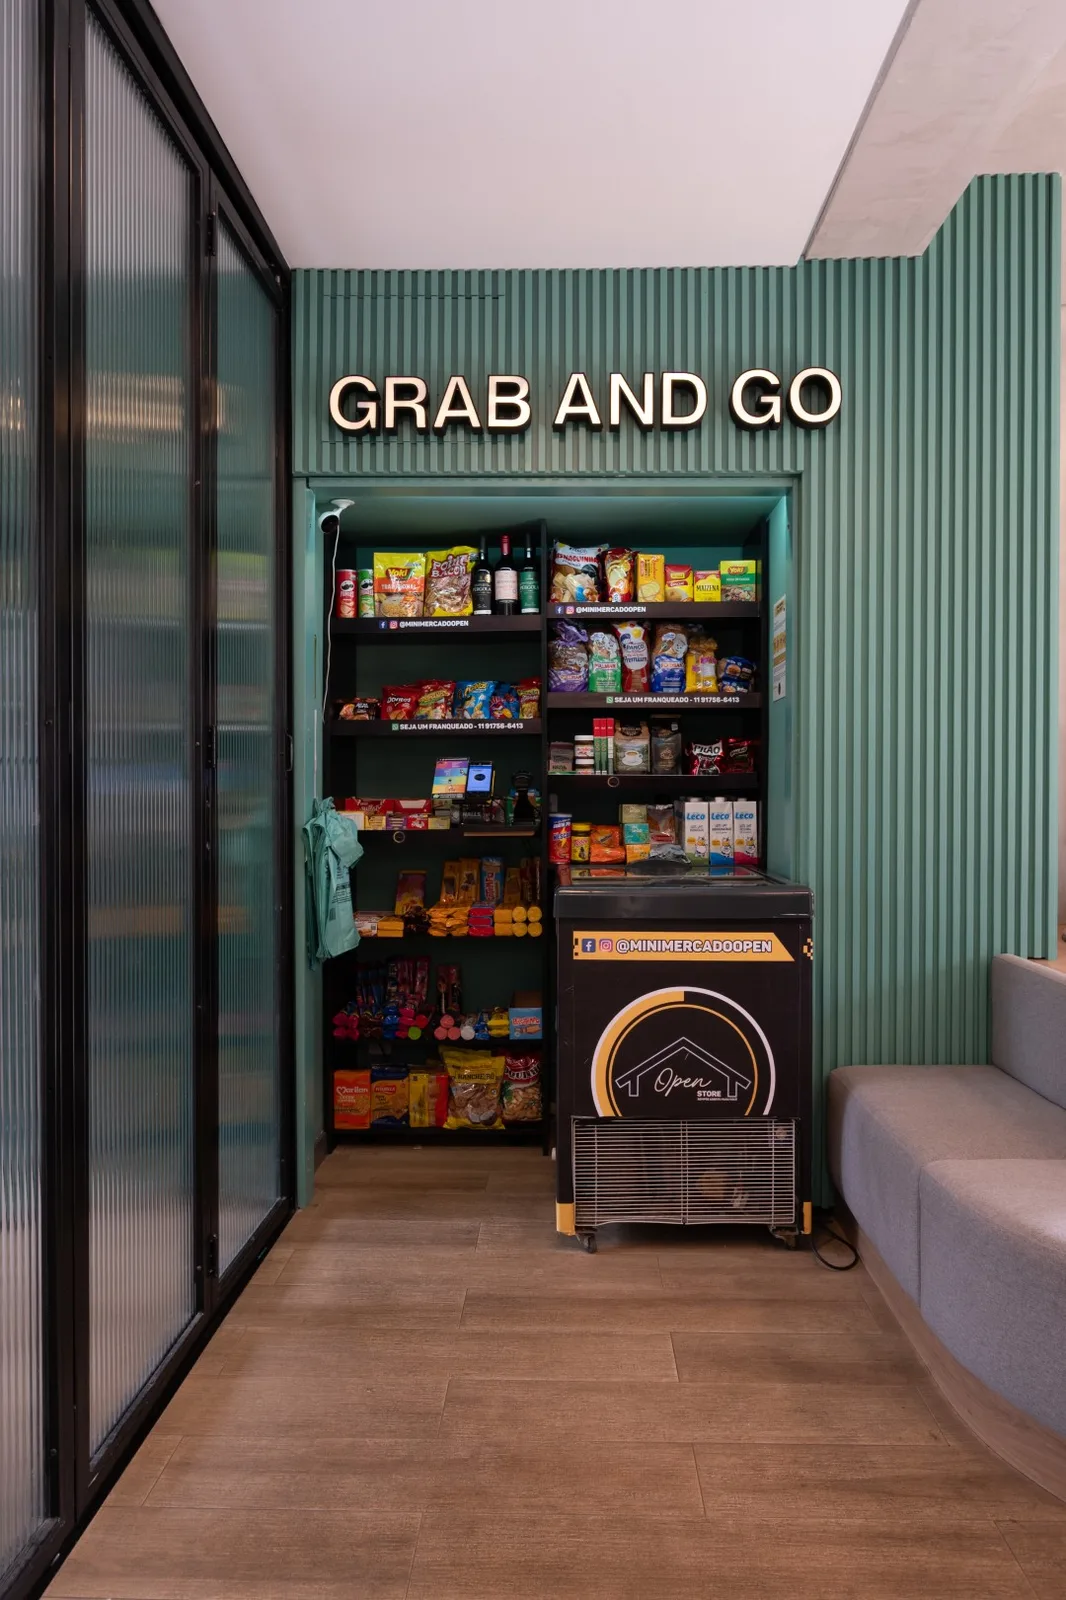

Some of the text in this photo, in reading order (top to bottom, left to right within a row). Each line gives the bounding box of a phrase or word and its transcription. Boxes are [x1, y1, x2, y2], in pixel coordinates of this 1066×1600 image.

[329, 367, 842, 434] GRAB AND GO
[575, 605, 646, 614] @MINIMERCADOOPEN
[399, 620, 469, 629] @MINIMERCADOOPEN
[428, 722, 474, 730] FRANQUEADO
[616, 938, 772, 954] @MINIMERCADOOPEN
[654, 1068, 712, 1097] Open
